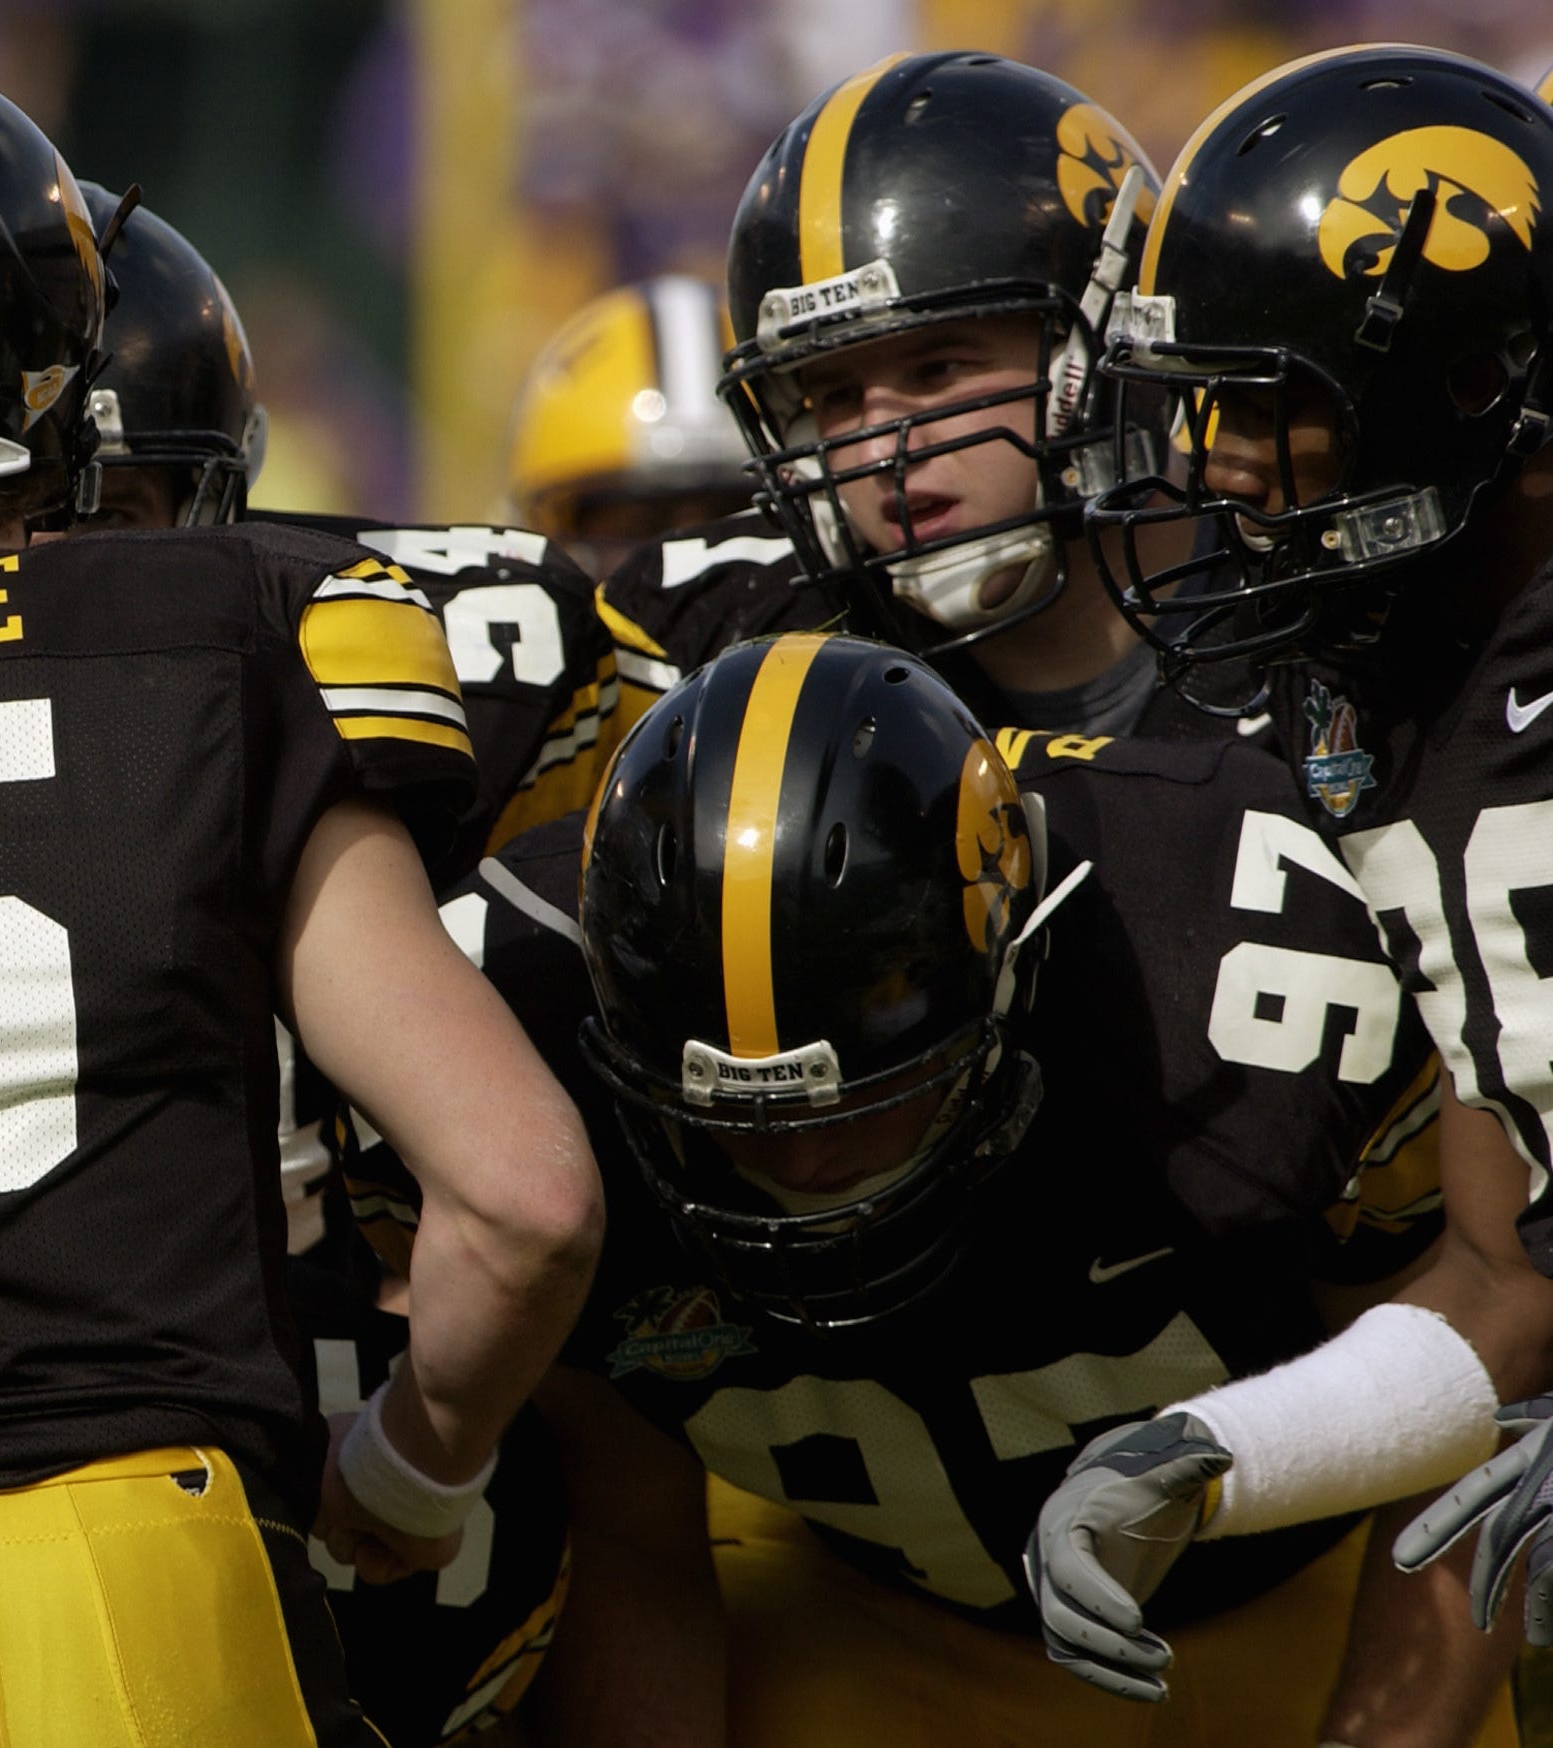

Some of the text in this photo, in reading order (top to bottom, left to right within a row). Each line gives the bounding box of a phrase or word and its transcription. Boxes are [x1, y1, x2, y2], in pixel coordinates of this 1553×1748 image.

[790, 281, 859, 315] BIG TEN
[1048, 363, 1083, 440] iddell
[1207, 809, 1401, 1085] 97
[718, 1062, 803, 1082] BIG TEN
